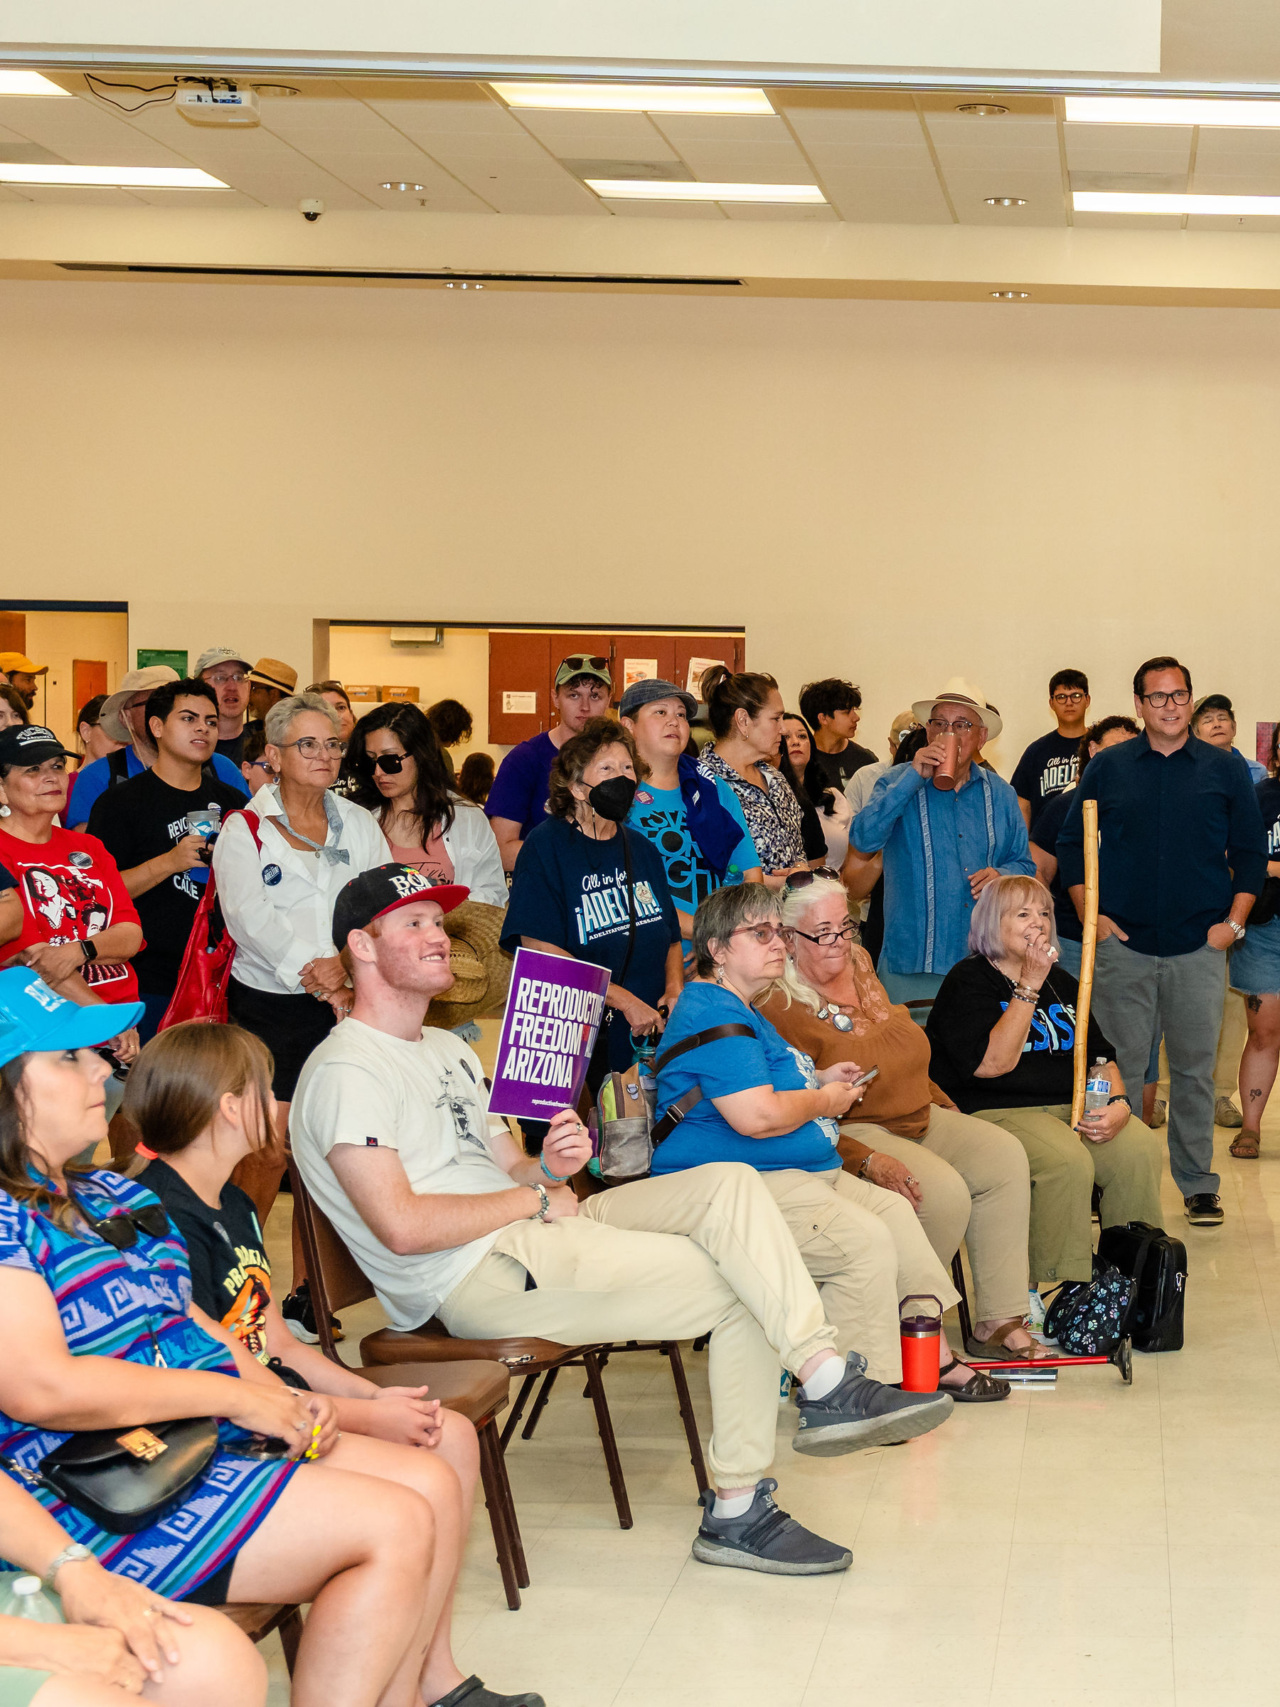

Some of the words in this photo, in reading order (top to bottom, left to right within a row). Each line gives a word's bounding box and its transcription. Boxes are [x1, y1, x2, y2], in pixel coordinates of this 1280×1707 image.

[582, 873, 600, 892] All
[602, 873, 614, 885] in
[508, 1011, 584, 1056] FREEDOM
[501, 1046, 574, 1089] ARIZONA
